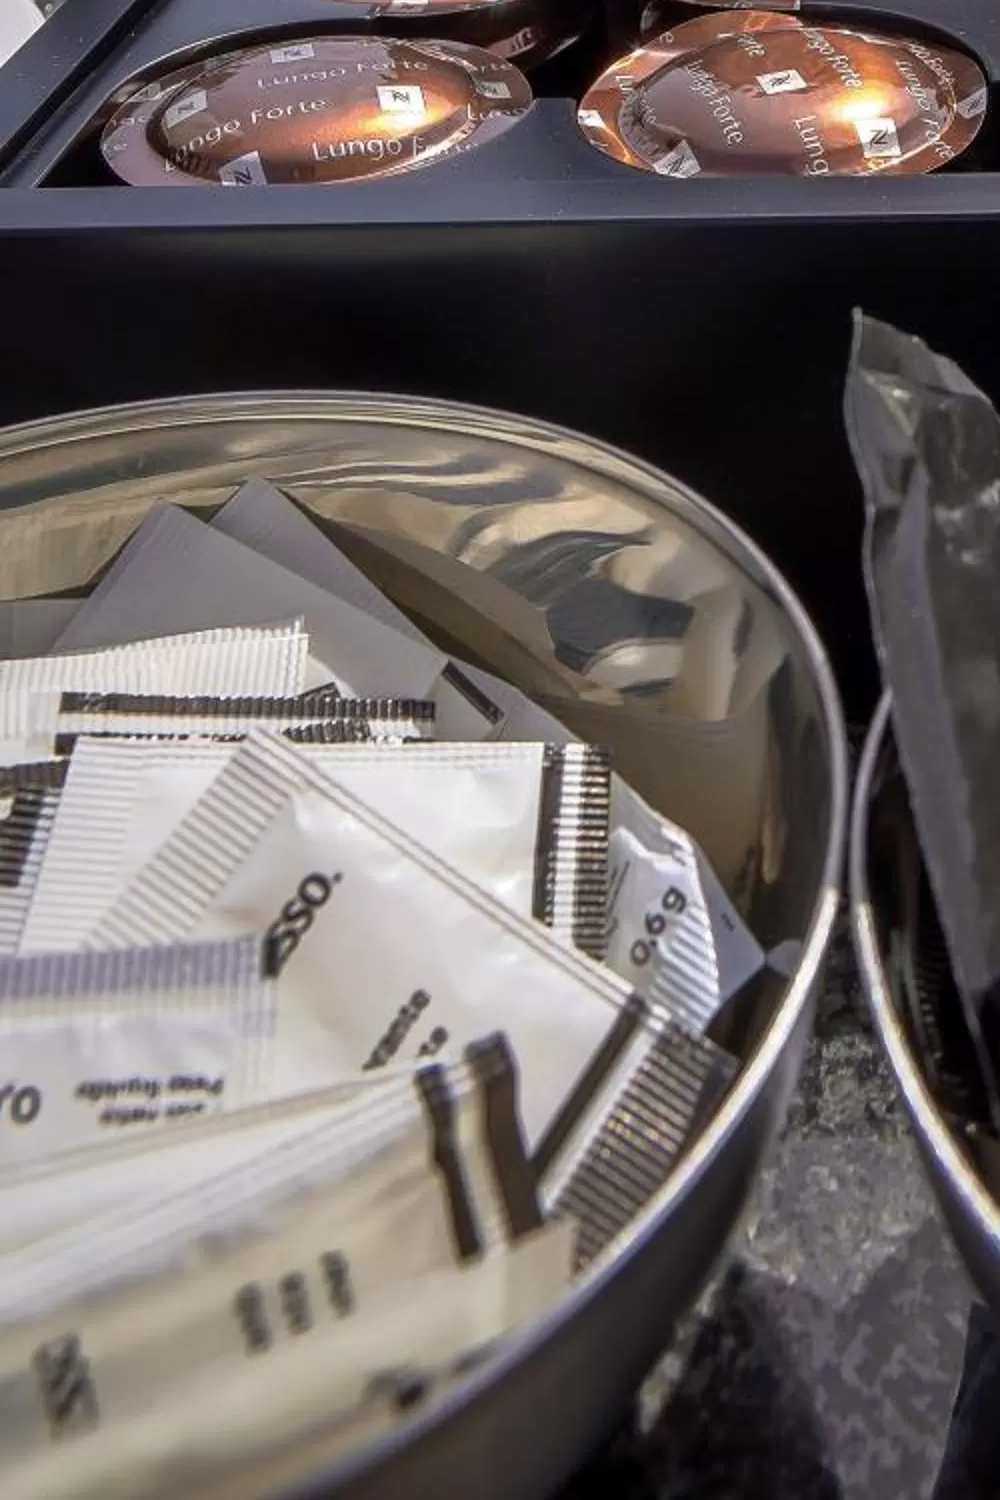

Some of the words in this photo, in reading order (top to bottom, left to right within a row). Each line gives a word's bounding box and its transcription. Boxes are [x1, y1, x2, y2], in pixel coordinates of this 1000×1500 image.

[257, 67, 347, 89] Lungo
[828, 53, 866, 88] Forte
[250, 98, 335, 123] Forte
[709, 92, 746, 147] Forte
[312, 137, 403, 162] Lungo
[793, 115, 831, 177] Lung
